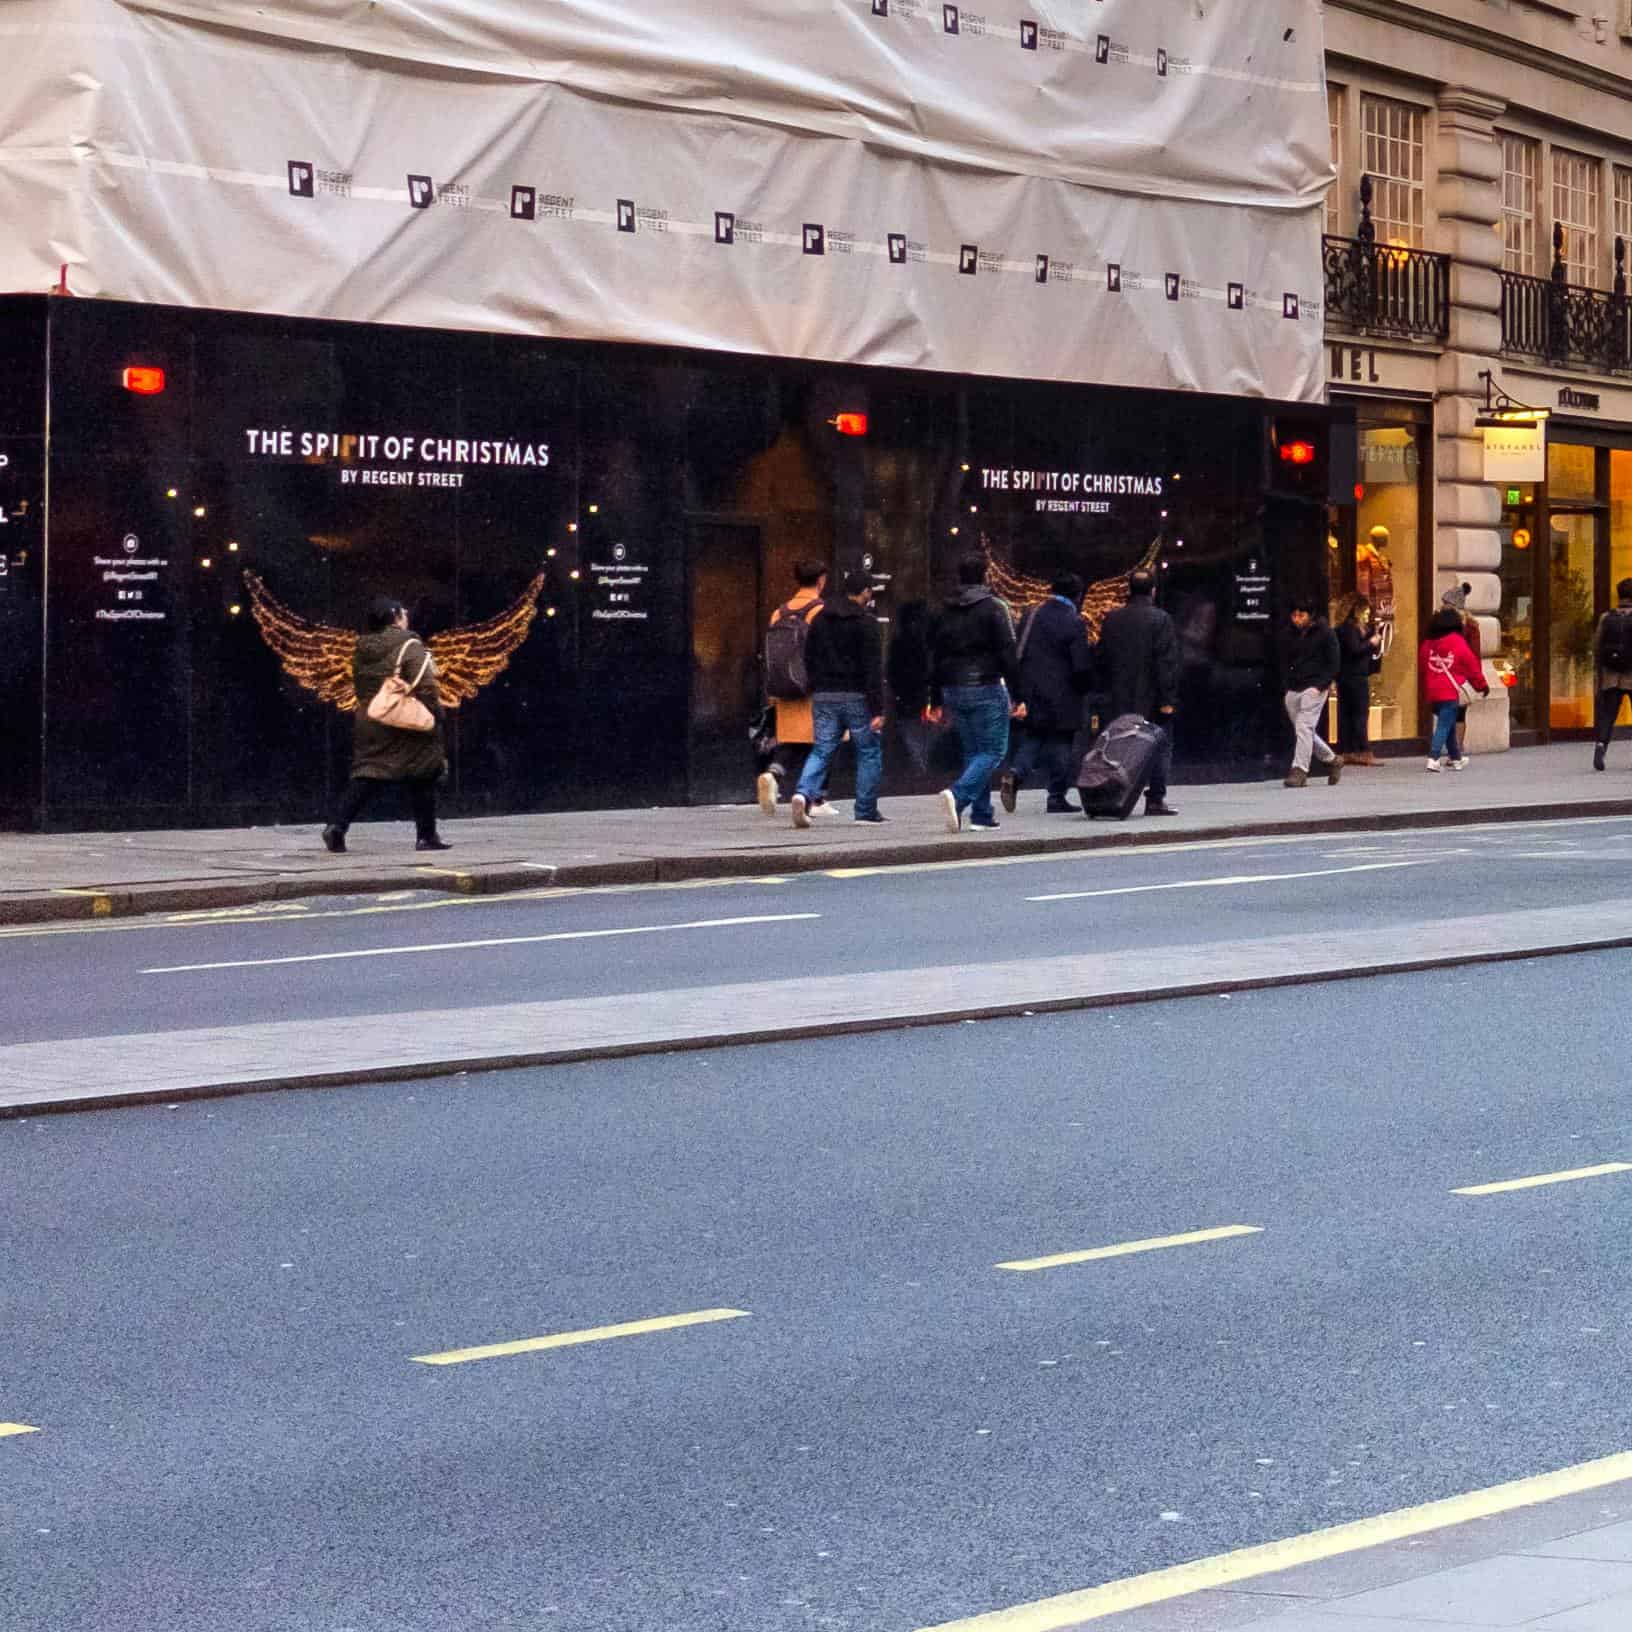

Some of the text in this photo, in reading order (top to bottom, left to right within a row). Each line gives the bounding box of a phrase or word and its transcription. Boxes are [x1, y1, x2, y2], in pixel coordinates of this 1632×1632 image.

[317, 169, 352, 185] REGENT
[538, 193, 575, 208] REGENT
[247, 429, 293, 456] THE
[384, 436, 414, 461] OF
[420, 438, 550, 467] CHRISTMAS
[341, 469, 464, 487] BY REGENT STREET
[982, 468, 1009, 489] THE
[1061, 474, 1080, 492] OF
[1083, 473, 1162, 495] CHRISTMAS
[1035, 499, 1110, 513] BY REGENT STREET
